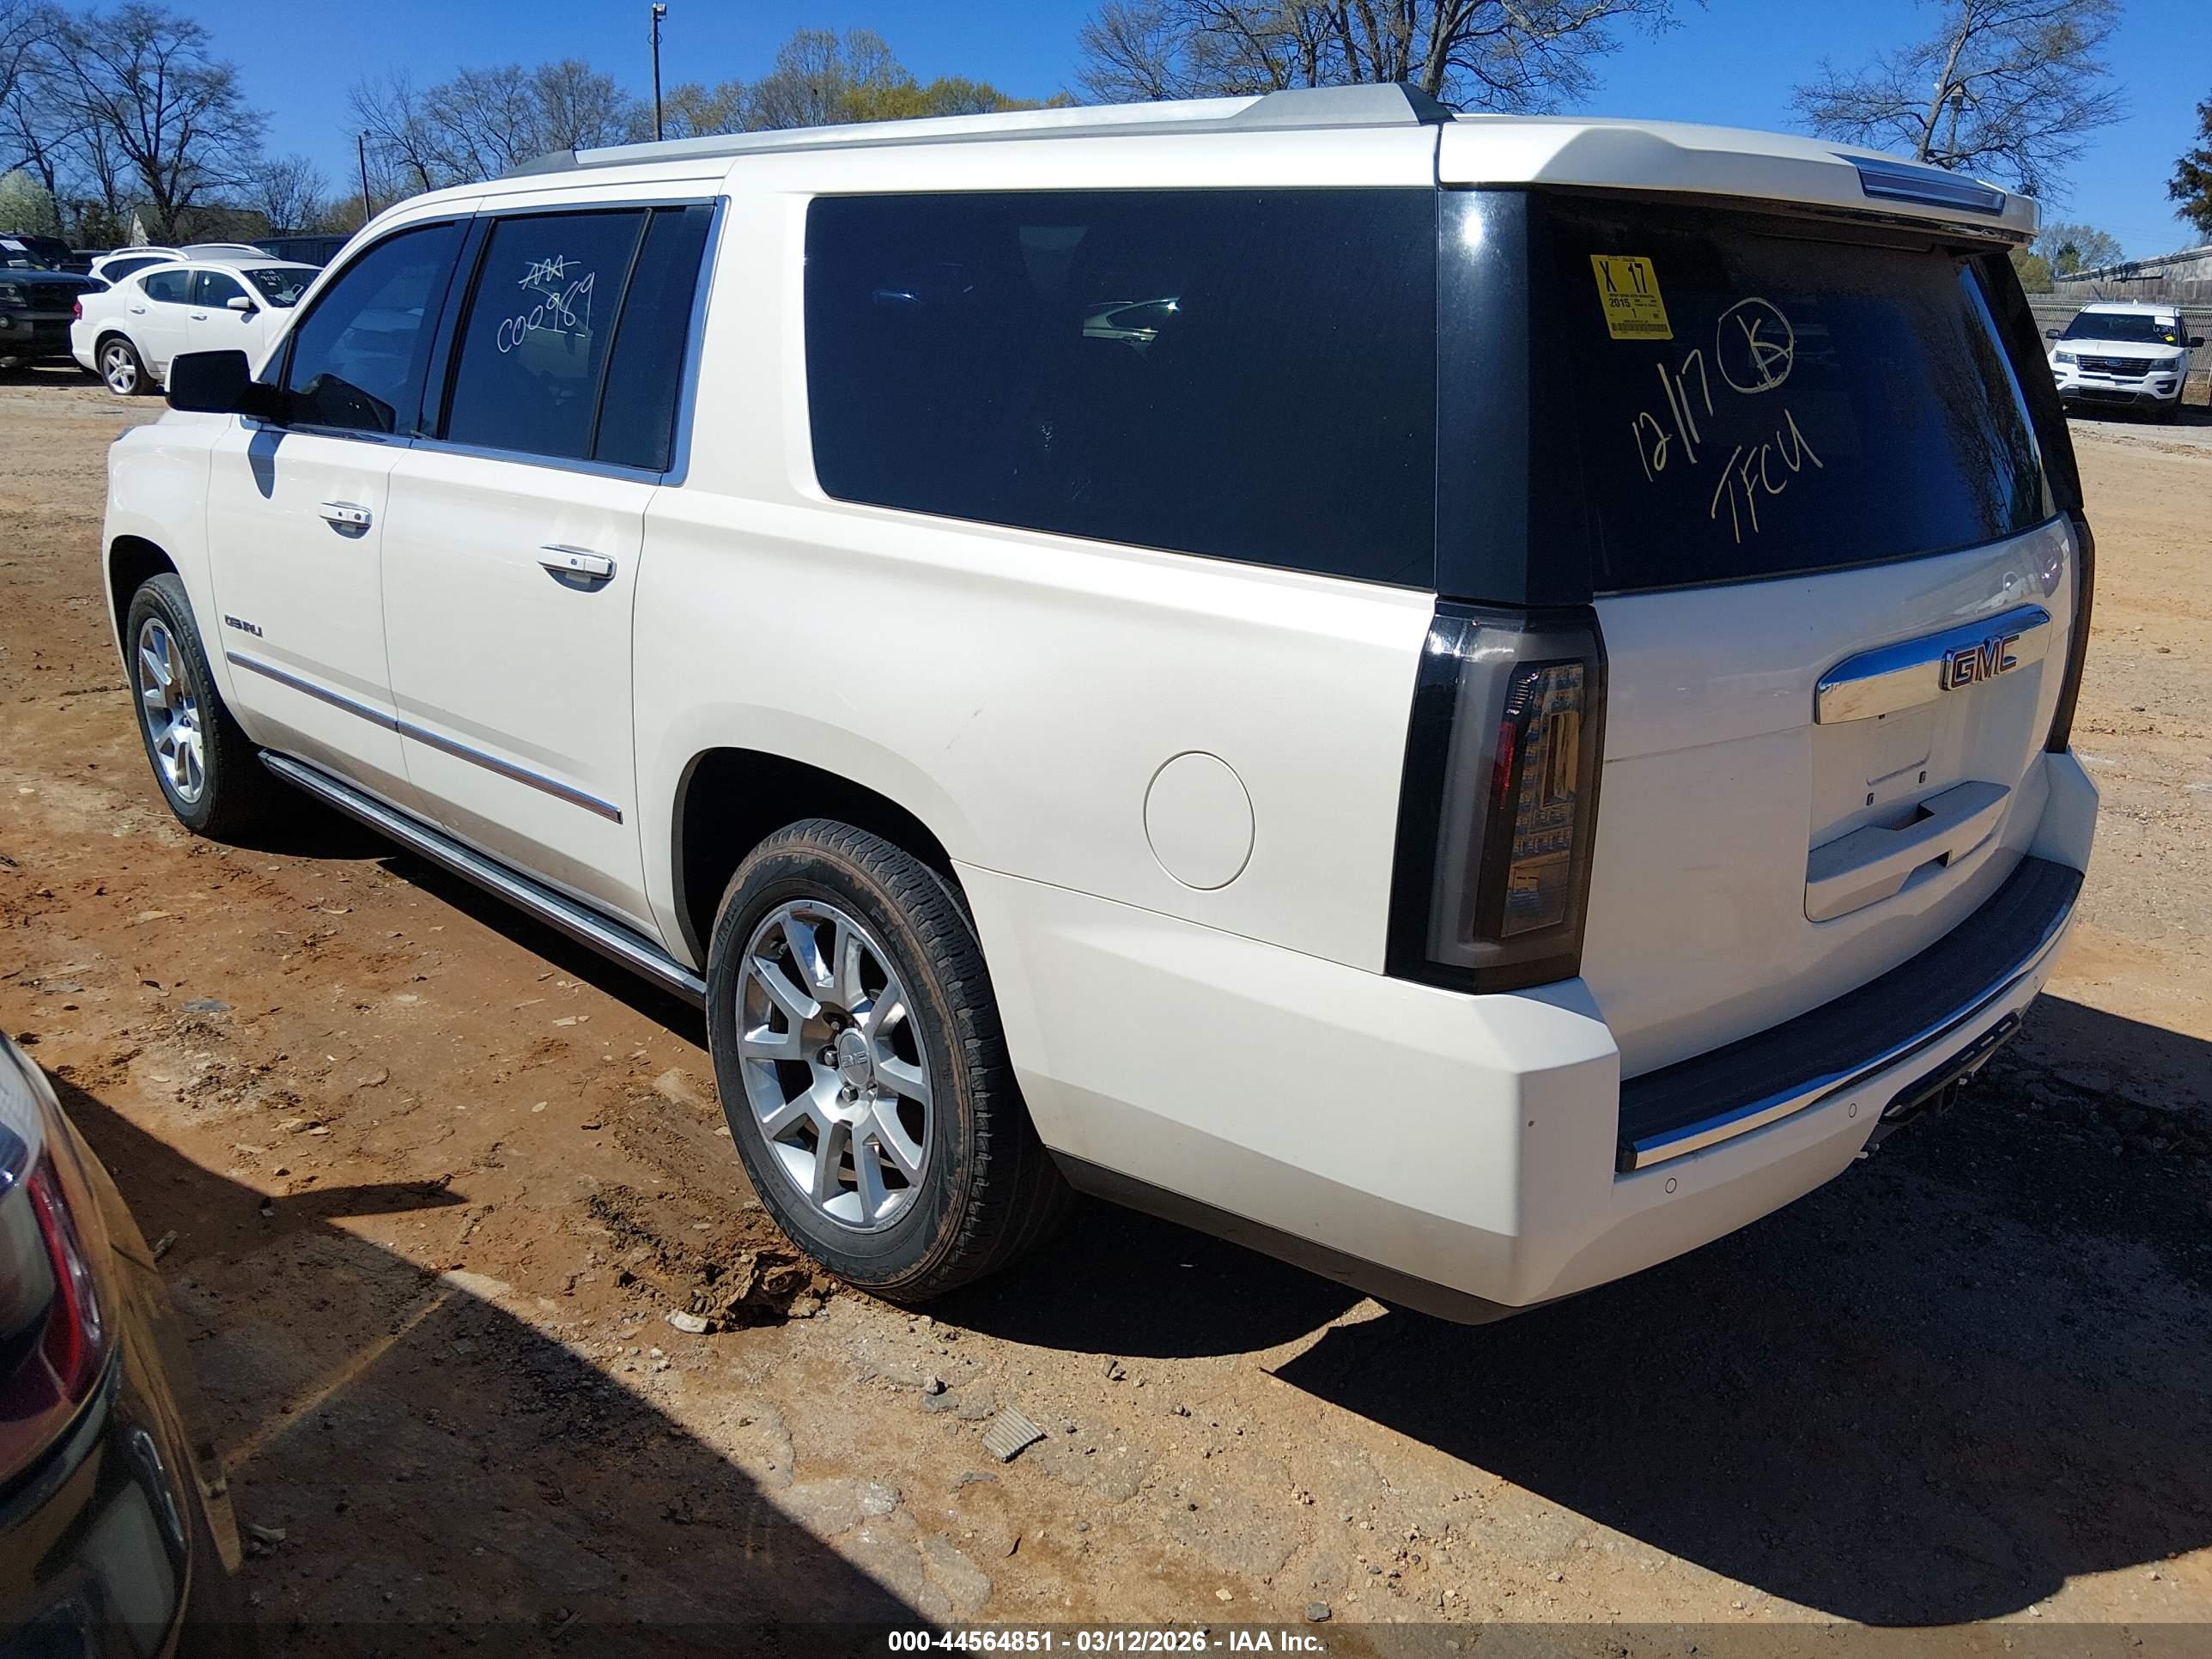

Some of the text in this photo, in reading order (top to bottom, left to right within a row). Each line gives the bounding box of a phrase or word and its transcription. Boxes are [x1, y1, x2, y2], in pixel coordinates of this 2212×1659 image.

[1598, 260, 1649, 294] X 17
[1608, 297, 1632, 308] 2015
[1632, 349, 1714, 483] 12/17
[1711, 409, 1824, 544] TFCU
[1941, 634, 2020, 690] GMC
